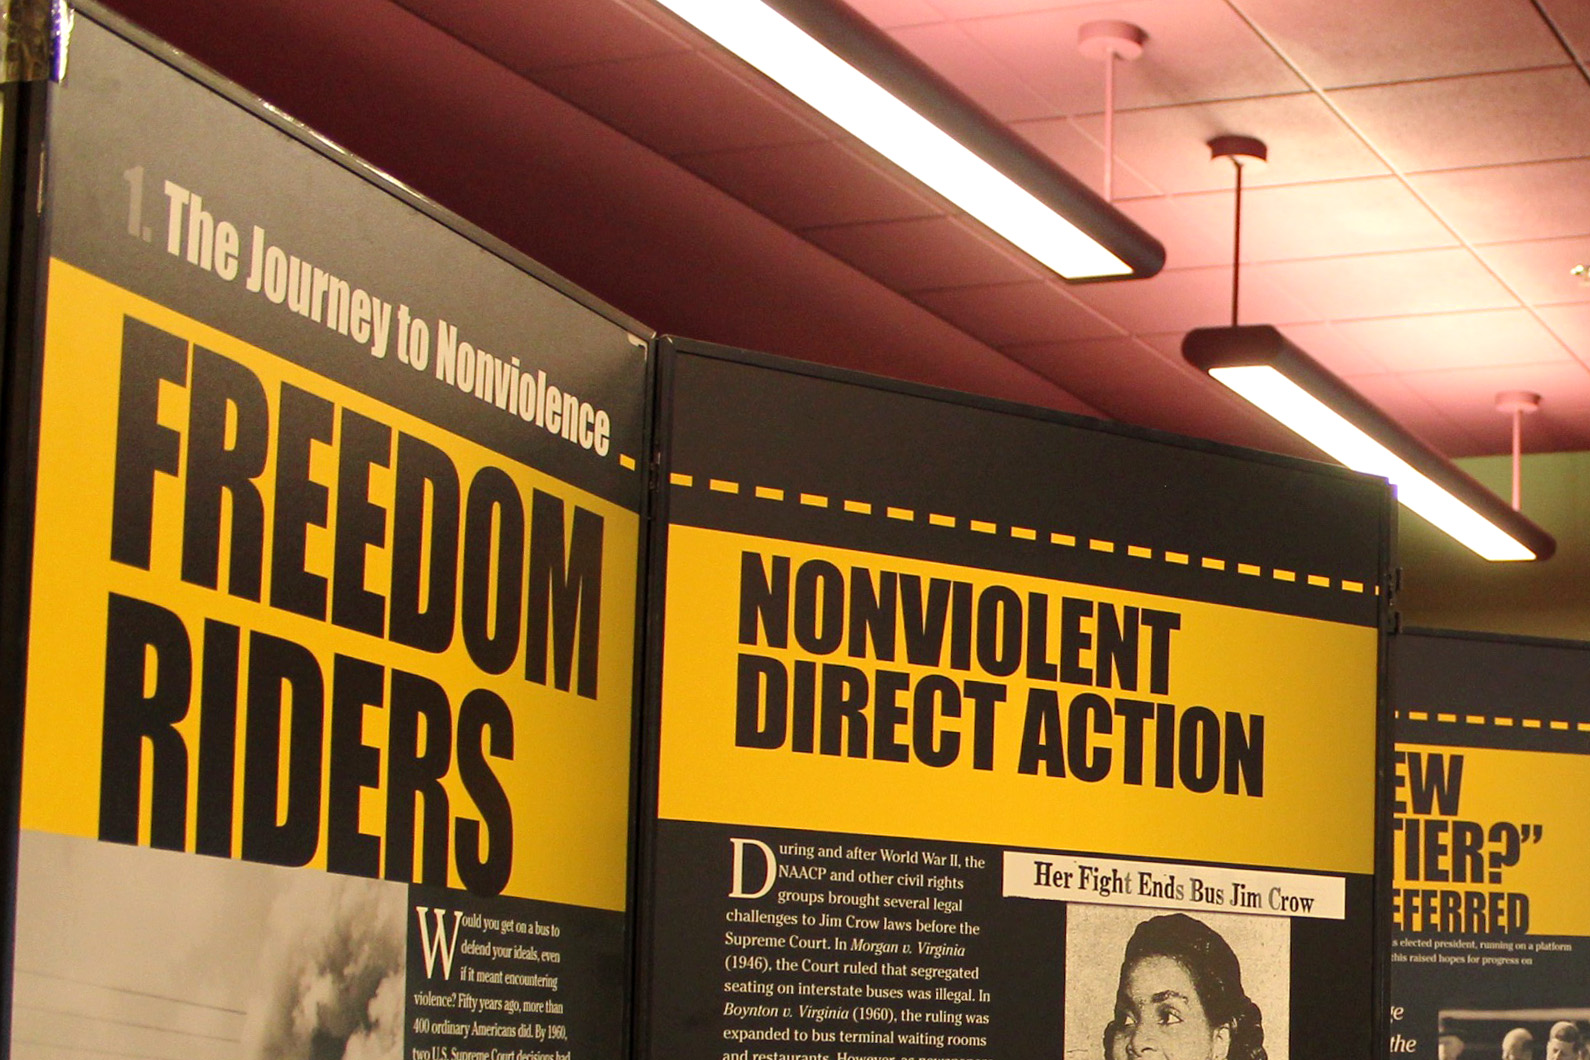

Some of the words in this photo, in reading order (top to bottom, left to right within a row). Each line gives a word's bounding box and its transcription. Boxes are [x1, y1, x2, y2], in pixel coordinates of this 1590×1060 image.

[164, 180, 240, 281] The
[246, 225, 393, 359] Journey
[398, 304, 429, 371] to
[436, 320, 612, 458] Nonviolence
[110, 314, 605, 701] FREEDOM
[738, 551, 1181, 697] NONVIOLENT
[98, 592, 516, 897] RIDERS
[735, 653, 1006, 771] DIRECT
[1018, 689, 1265, 799] ACTION
[817, 845, 842, 859] and
[846, 846, 877, 861] after
[880, 848, 918, 864] World
[922, 851, 947, 866] War
[950, 853, 961, 868] II,
[965, 855, 986, 869] the
[778, 864, 827, 880] NAACP
[830, 869, 855, 882] and
[858, 871, 894, 885] other
[897, 873, 924, 887] civil
[927, 876, 964, 891] rights
[1034, 861, 1073, 889] Her
[1078, 865, 1131, 894] Fight
[1138, 872, 1184, 900] Ends
[1190, 878, 1224, 905] Bus
[1230, 883, 1262, 908] Jim
[1269, 887, 1315, 914] Crow
[726, 909, 798, 927] challenges
[802, 914, 816, 926] to
[819, 913, 842, 928] Jim
[845, 915, 880, 929] Crow
[883, 917, 912, 931] laws
[916, 919, 956, 934] before
[959, 921, 980, 935] the
[778, 891, 824, 906] groups
[828, 891, 880, 909] brought
[883, 897, 930, 910] several
[933, 897, 963, 914] legal
[482, 918, 500, 933] you
[500, 919, 514, 935] get
[515, 922, 527, 934] on
[527, 923, 534, 935] a
[535, 921, 550, 936] bus
[551, 924, 560, 938] to
[460, 939, 491, 956] defend
[492, 946, 513, 960] your
[513, 945, 540, 962] ideals,
[541, 951, 561, 963] even
